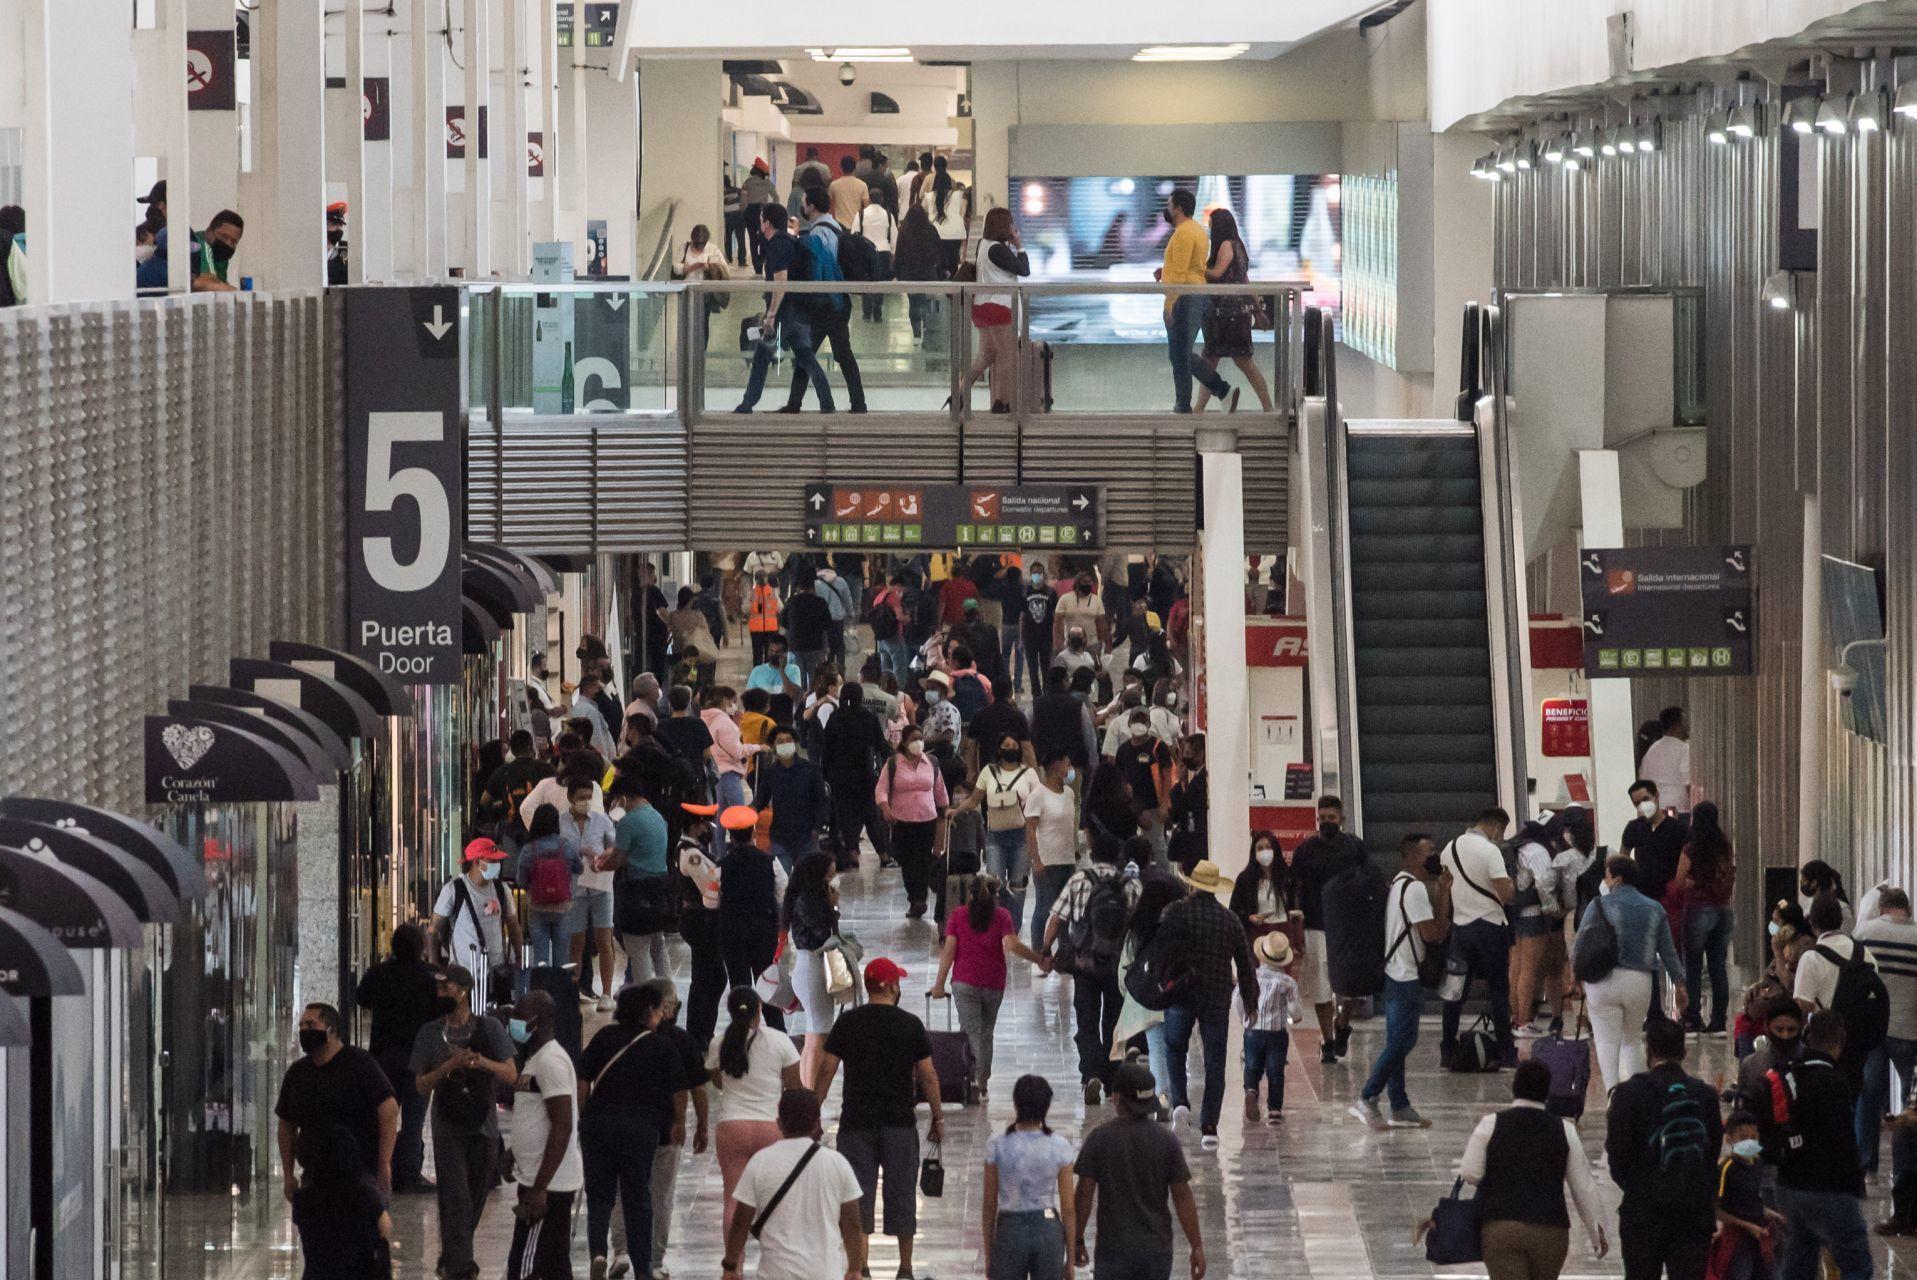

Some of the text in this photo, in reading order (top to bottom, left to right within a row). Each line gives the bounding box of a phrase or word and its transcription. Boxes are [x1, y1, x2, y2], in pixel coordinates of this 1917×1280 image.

[362, 411, 450, 592] 5
[1002, 496, 1061, 505] Salida nacional
[1637, 573, 1720, 582] Salida internacional
[361, 621, 452, 647] Puerta
[379, 652, 434, 675] Door
[162, 775, 216, 789] Corazón
